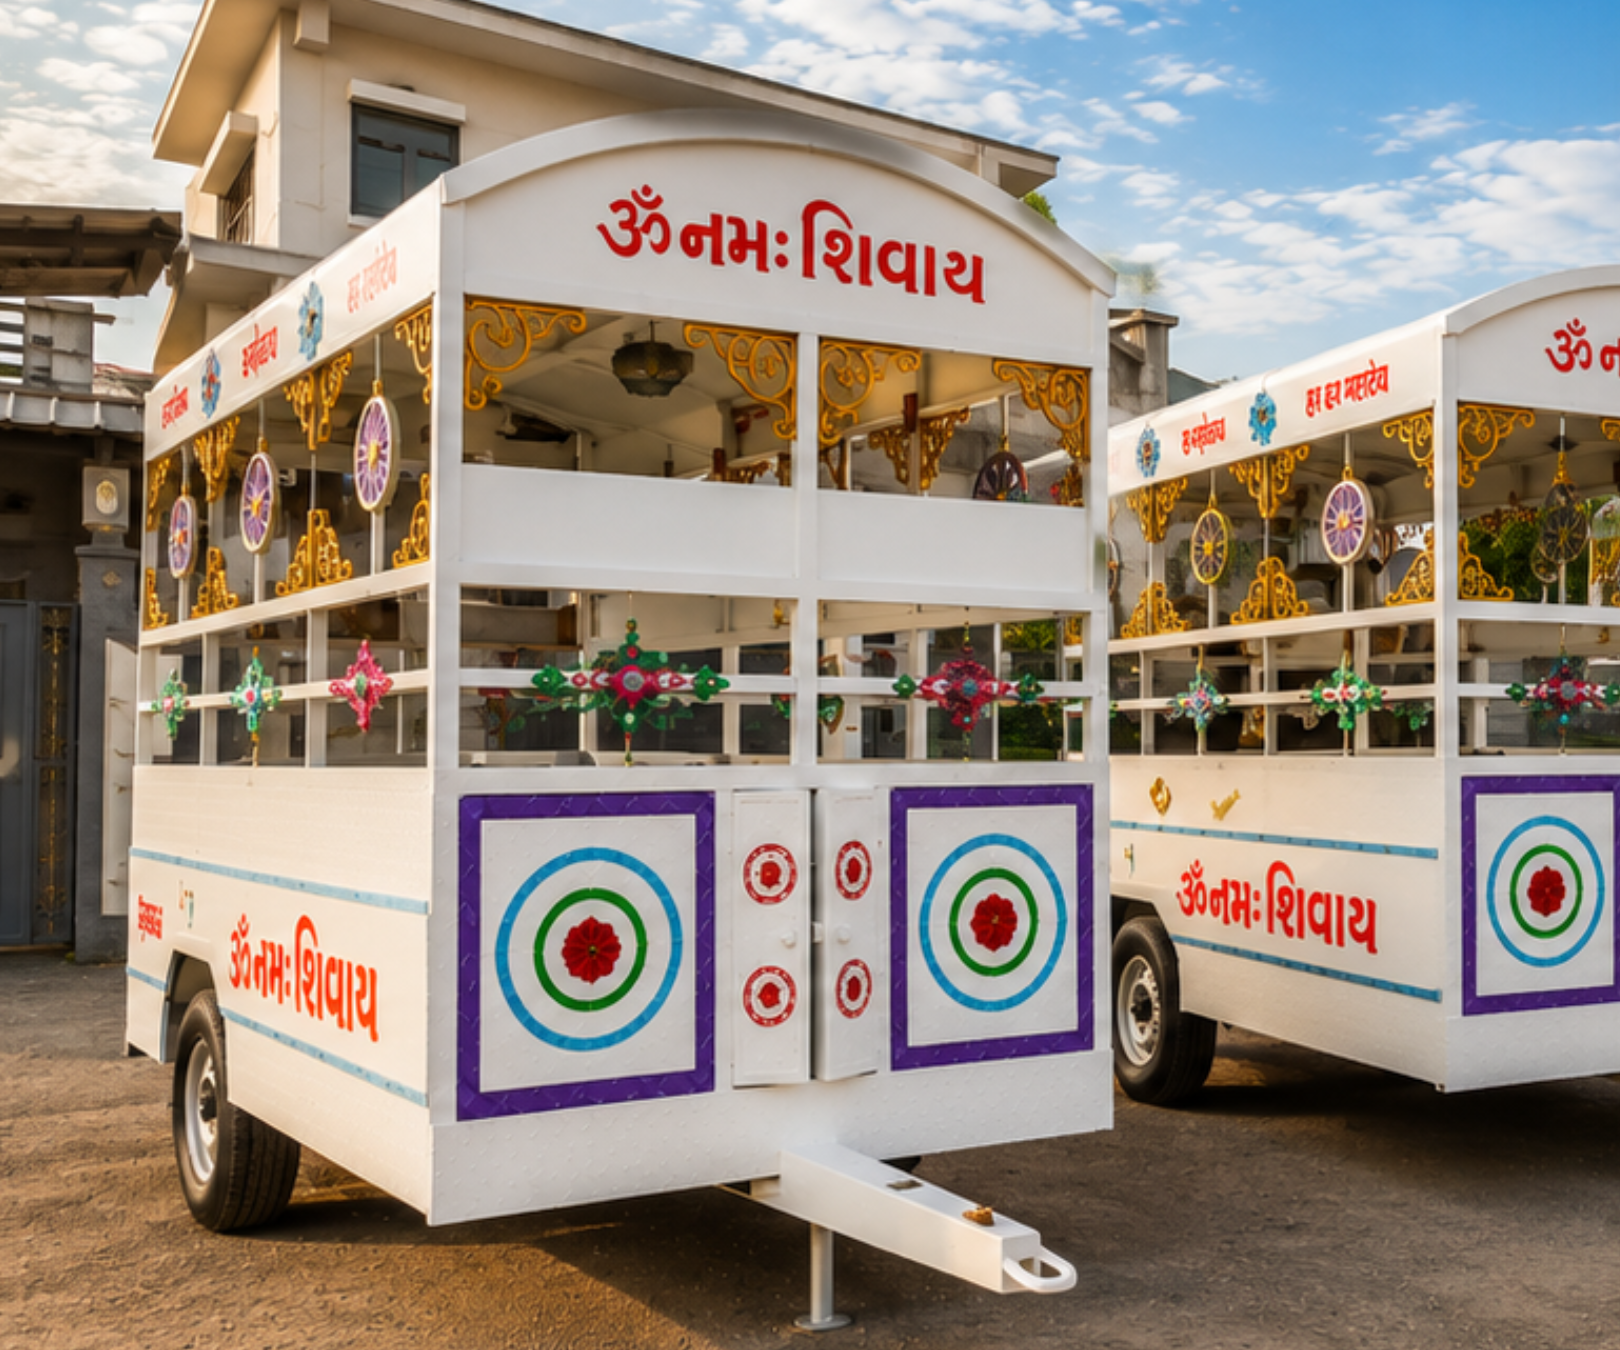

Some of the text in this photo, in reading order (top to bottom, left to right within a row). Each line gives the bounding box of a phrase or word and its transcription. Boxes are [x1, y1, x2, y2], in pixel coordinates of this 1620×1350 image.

[802, 199, 986, 304] શિવાય
[1266, 860, 1378, 955] શિવાય
[295, 914, 379, 1043] શિવાય
